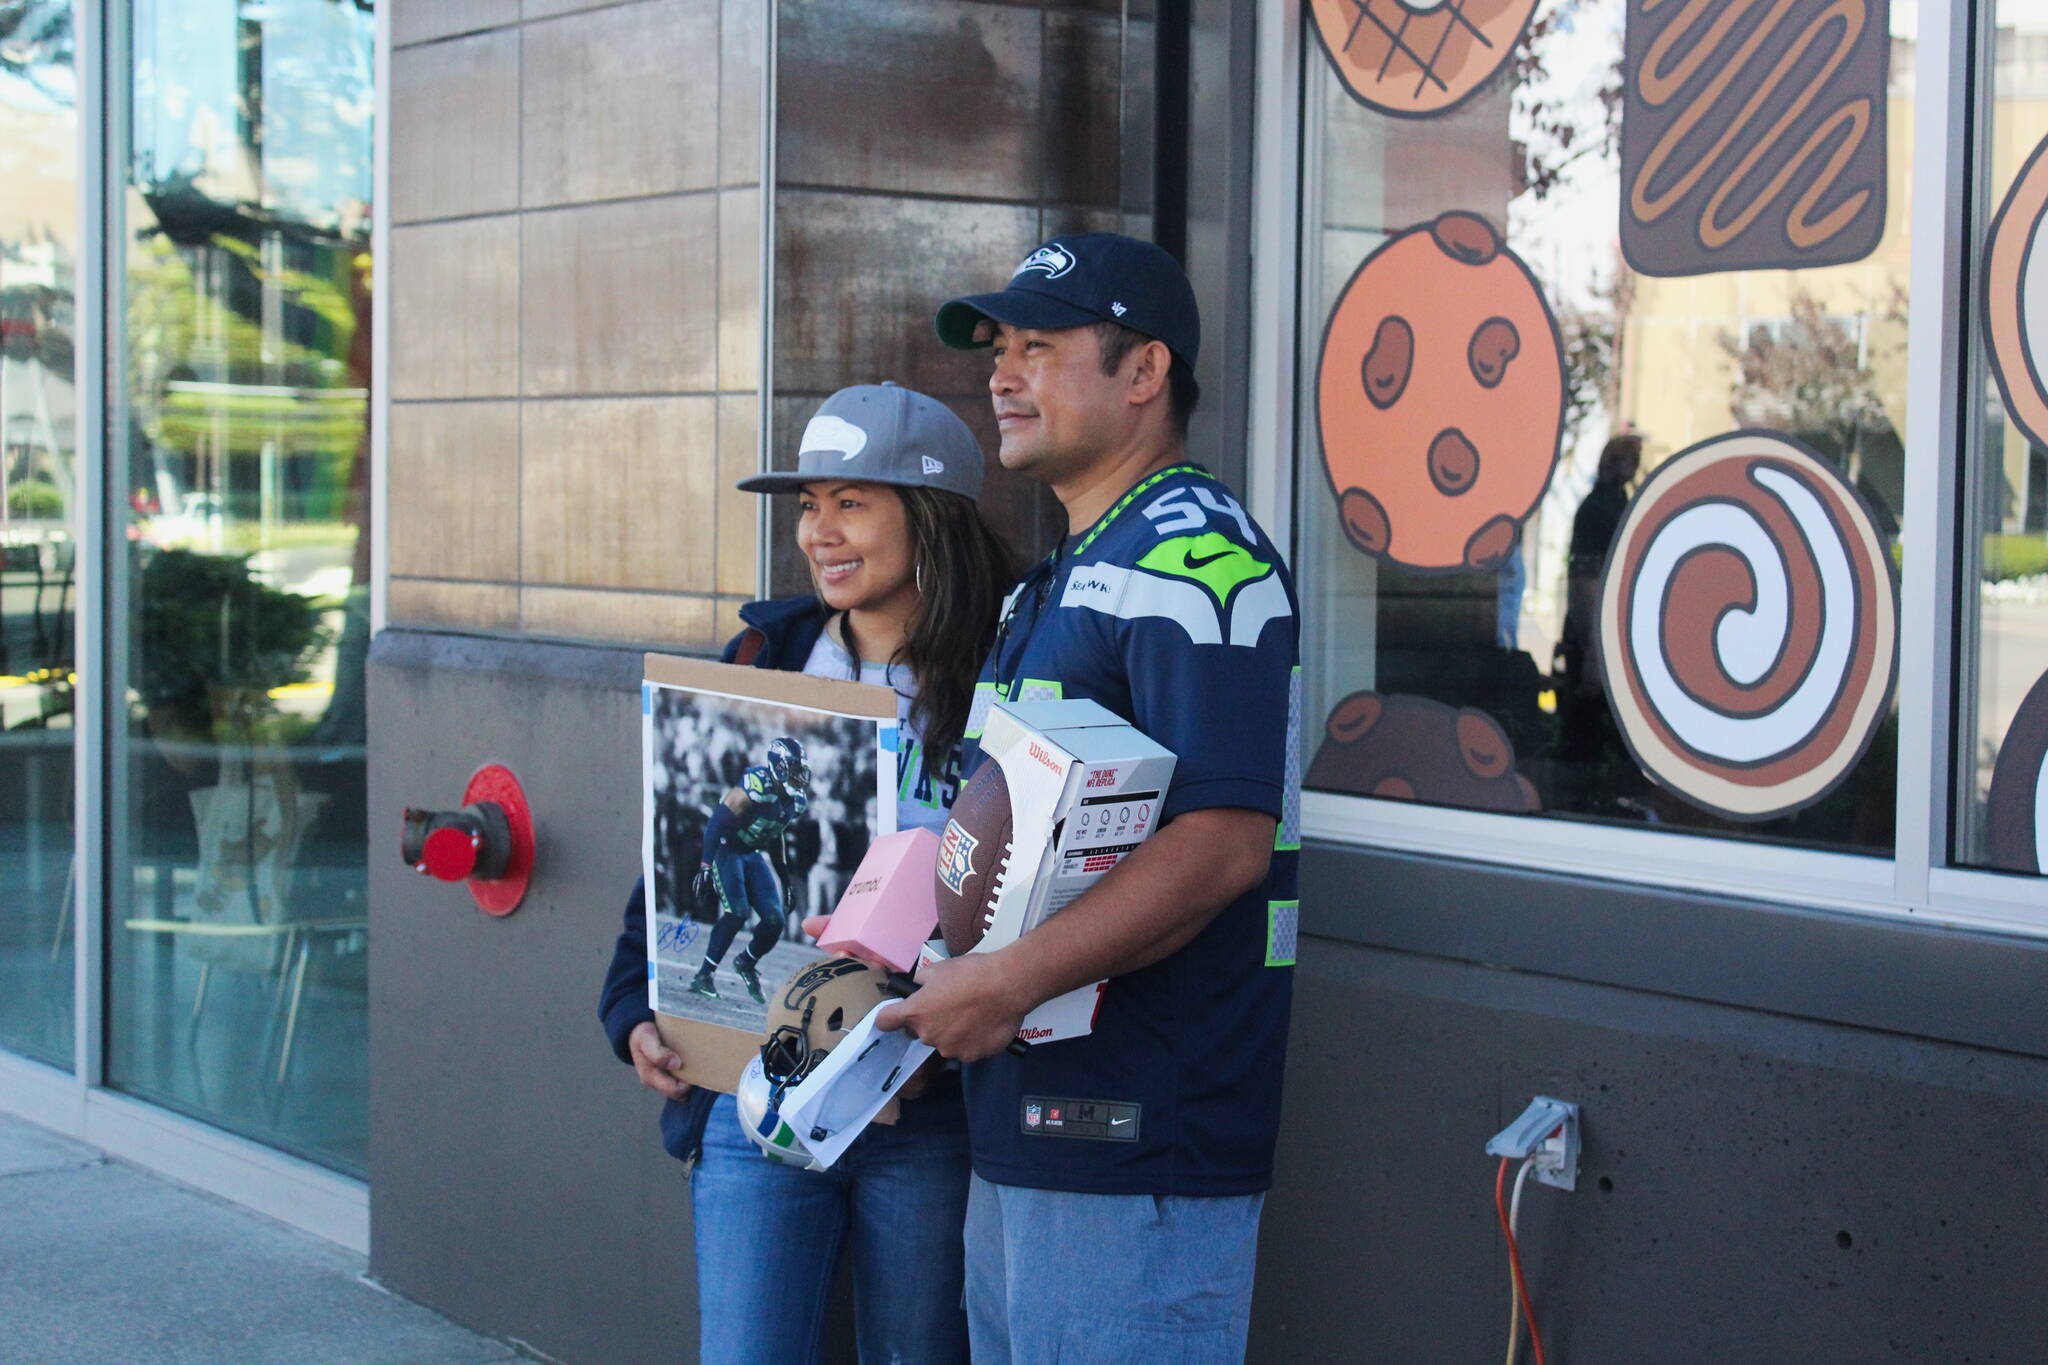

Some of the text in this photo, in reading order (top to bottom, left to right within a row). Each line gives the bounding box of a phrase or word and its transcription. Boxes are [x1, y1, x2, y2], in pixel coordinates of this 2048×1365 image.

[1141, 486, 1258, 546] 54
[1028, 742, 1063, 777] Wilson
[939, 828, 960, 870] NFL
